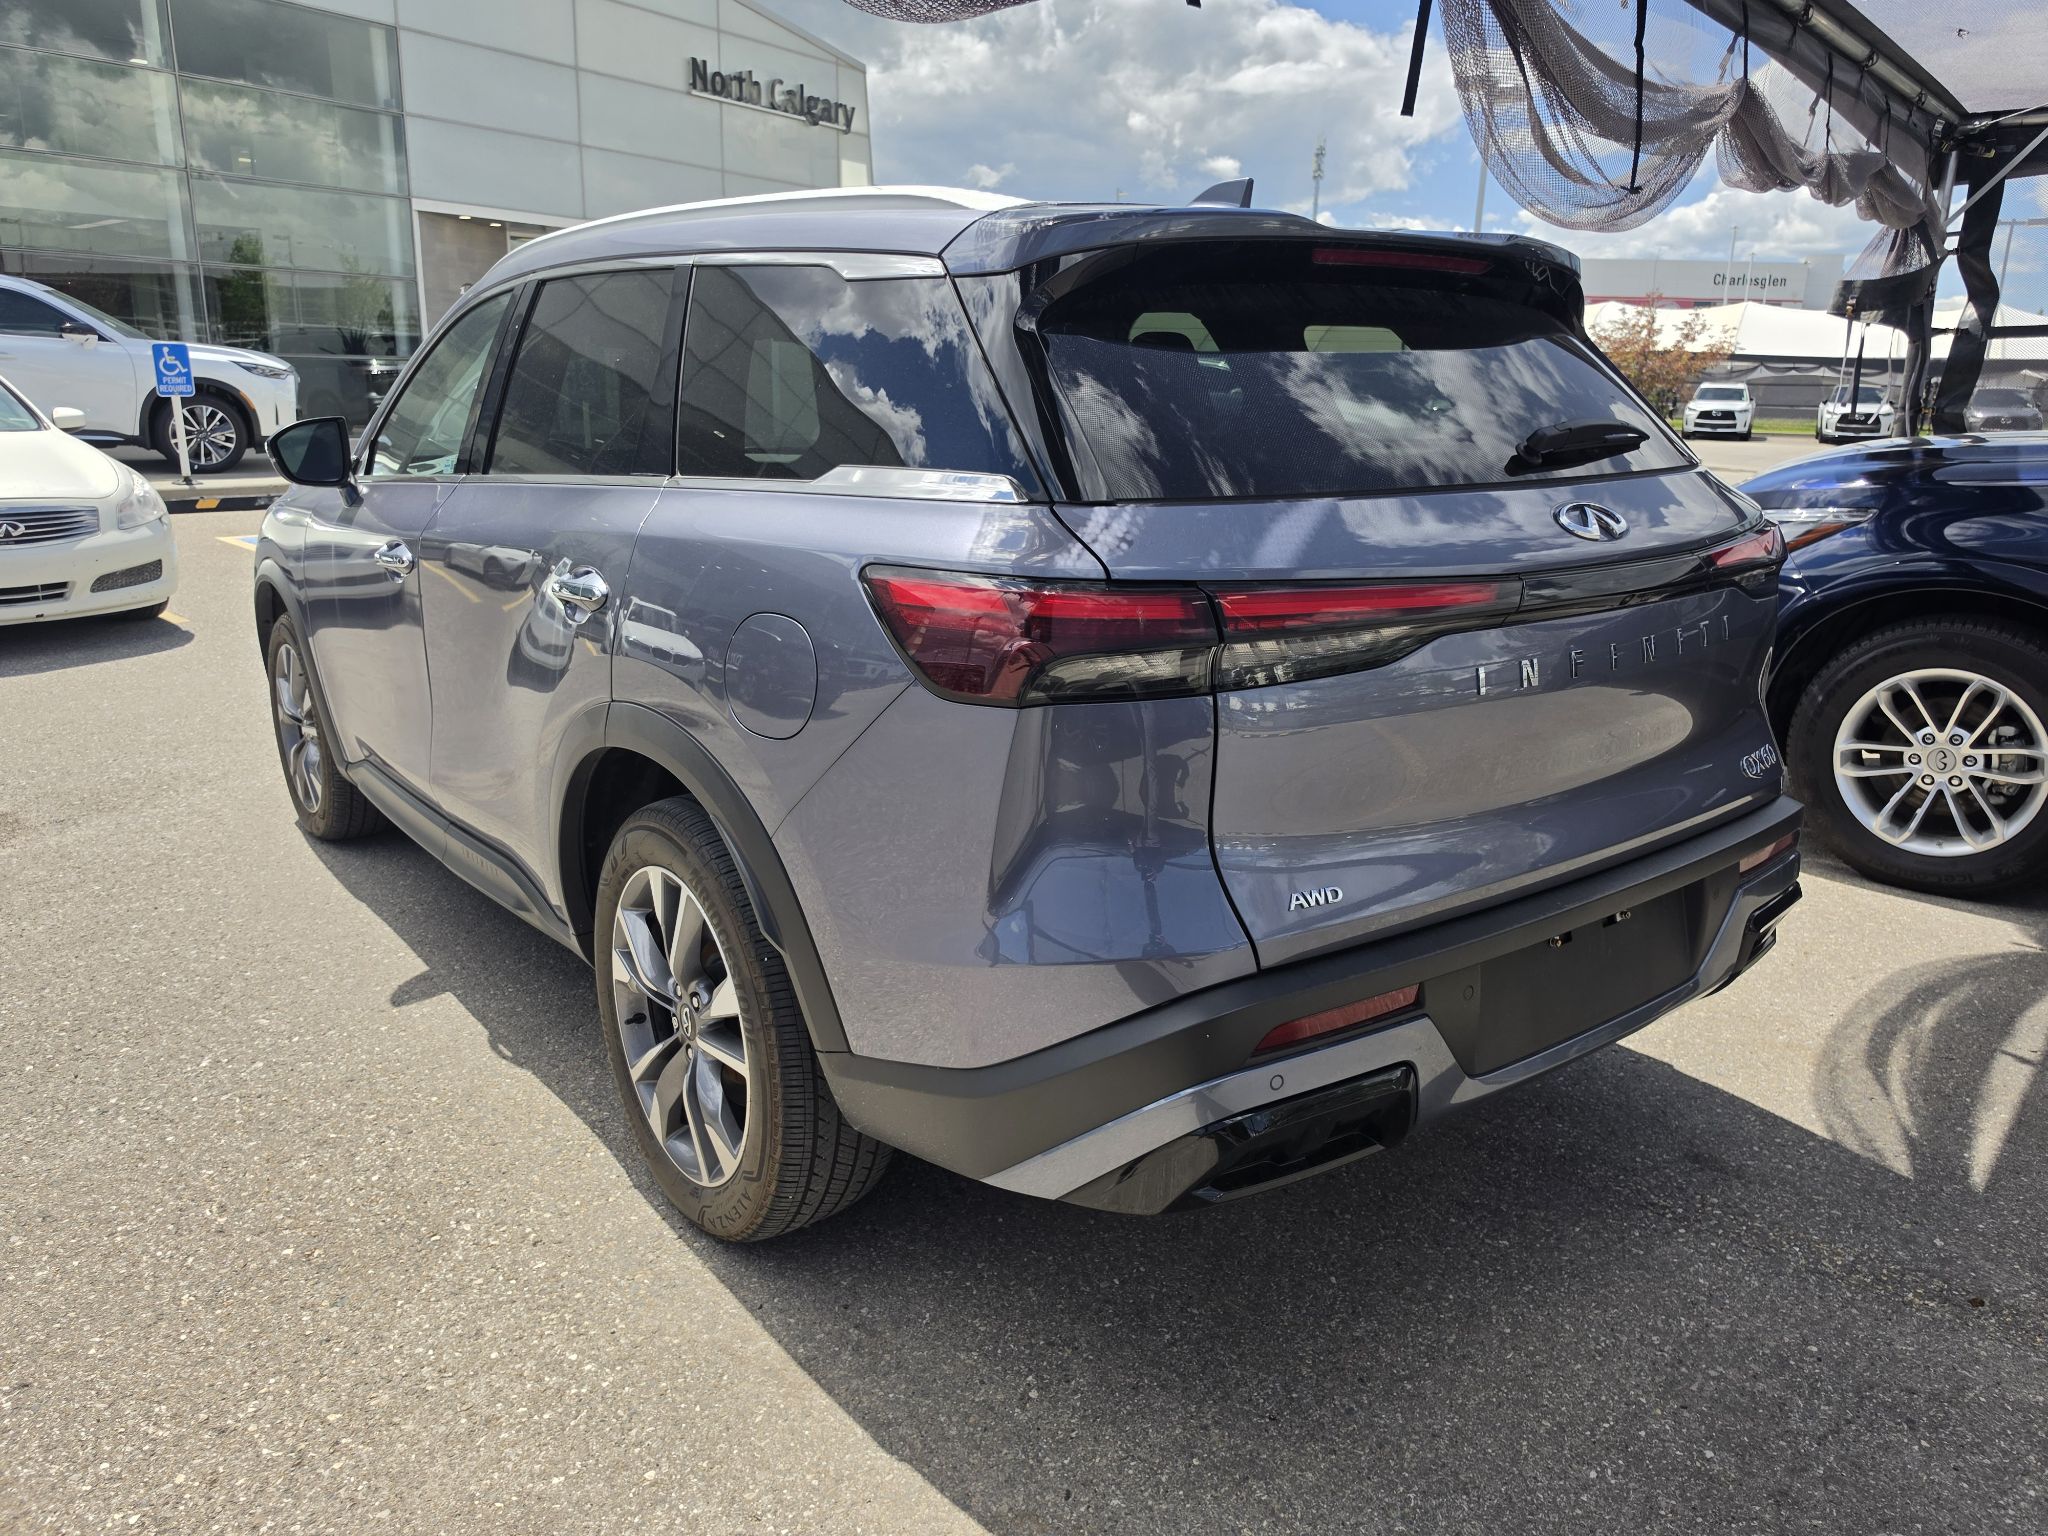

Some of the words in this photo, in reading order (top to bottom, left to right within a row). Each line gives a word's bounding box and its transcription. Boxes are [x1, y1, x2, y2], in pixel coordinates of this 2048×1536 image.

[688, 57, 762, 106] North
[768, 79, 856, 135] Calgary
[159, 384, 192, 392] REQUIRED
[162, 376, 187, 384] PERMIT
[1475, 615, 1729, 696] INFINITI
[1741, 744, 1777, 778] QX60
[1288, 886, 1344, 912] AWD
[708, 1185, 752, 1230] ALENZA
